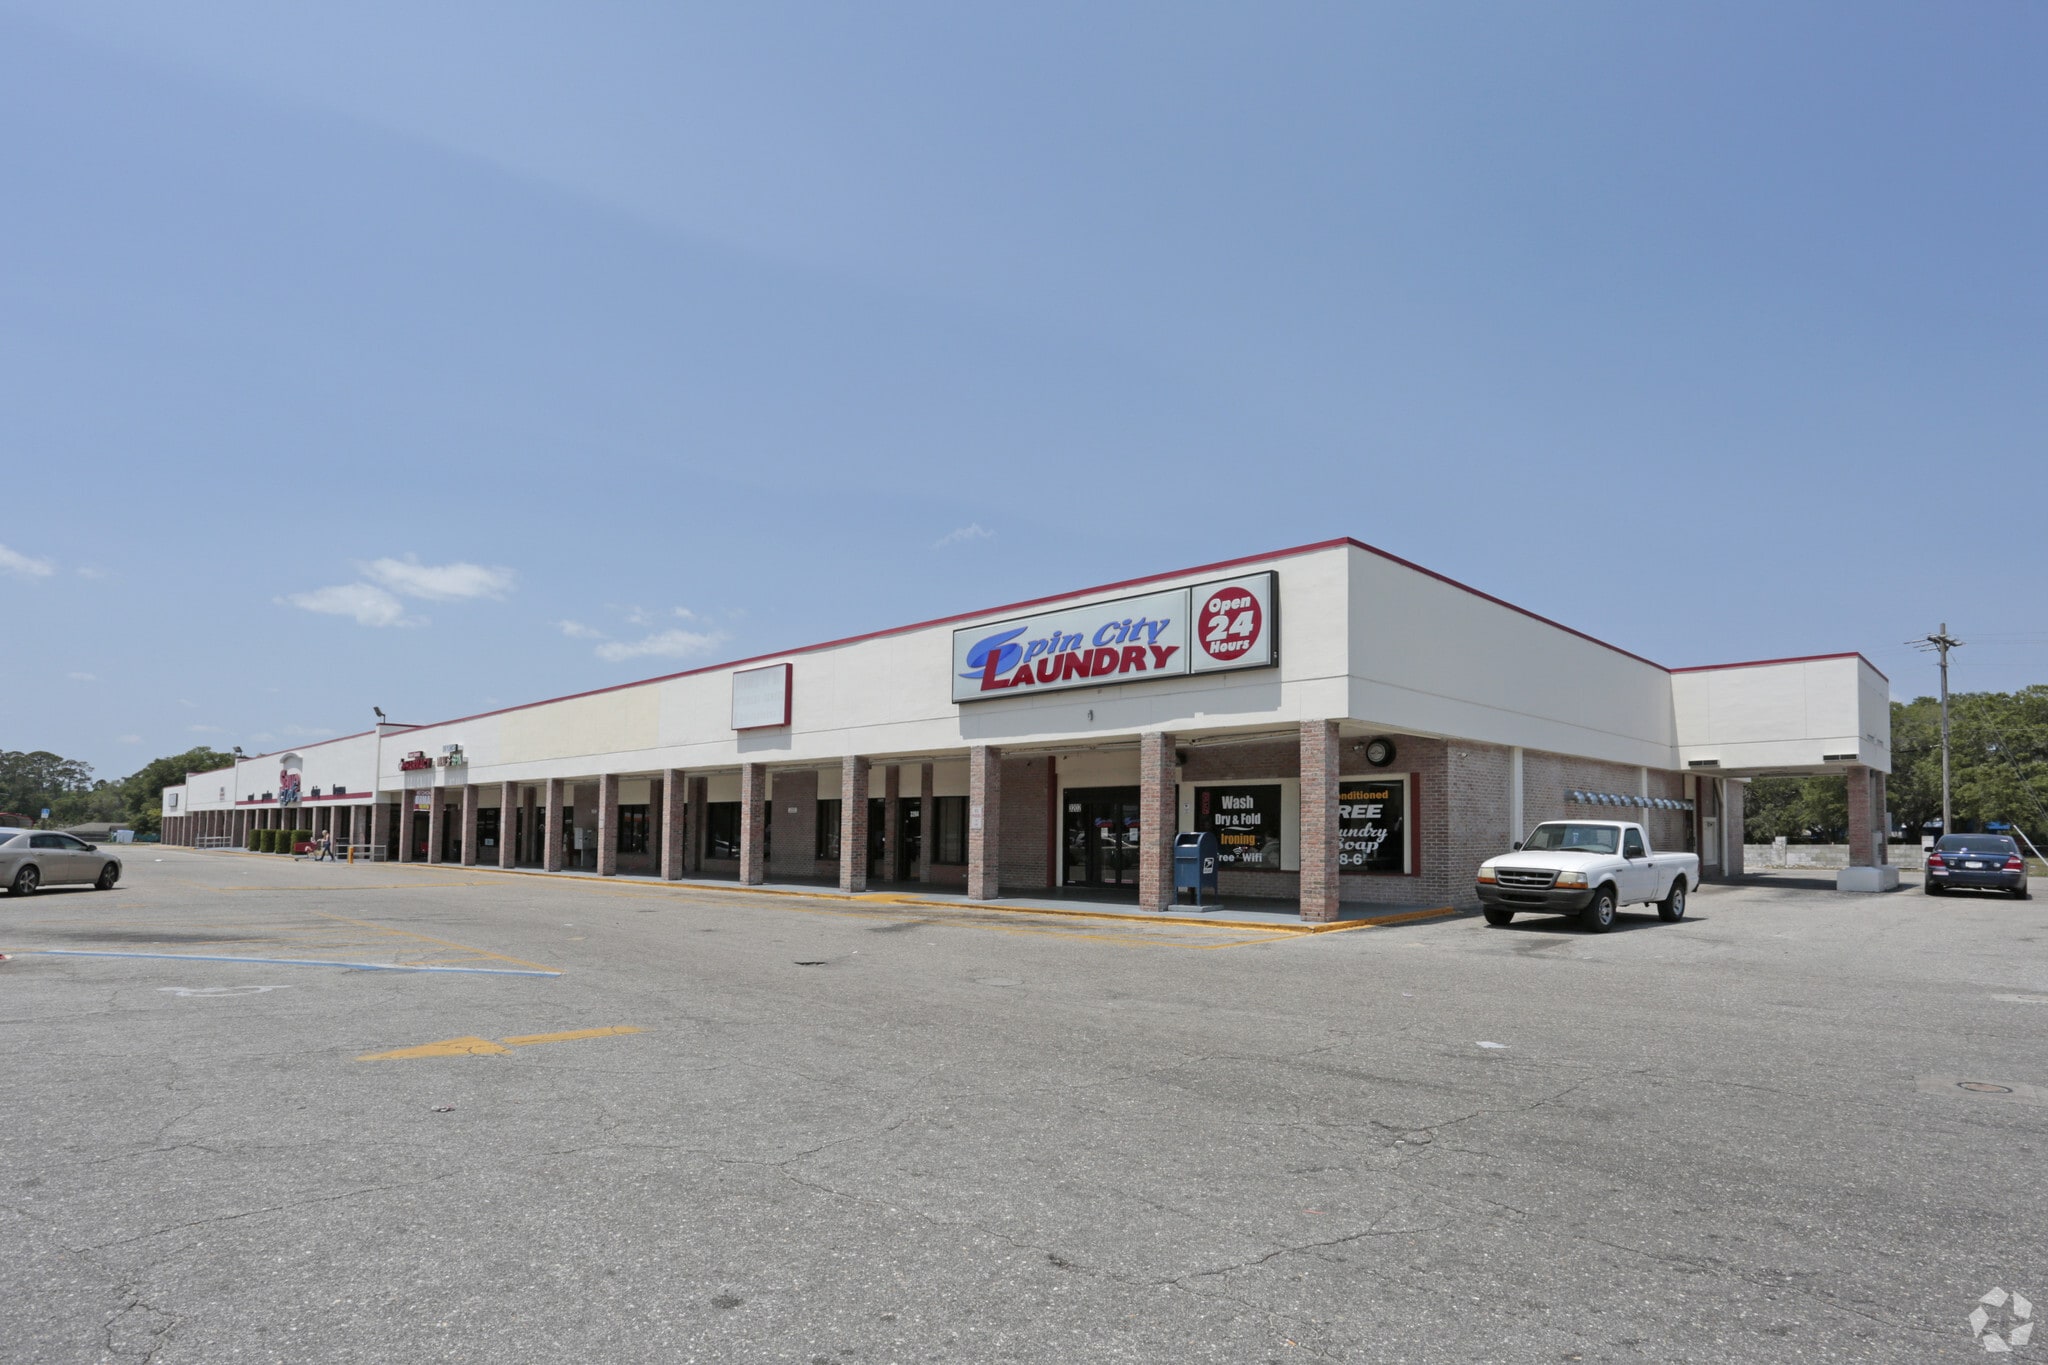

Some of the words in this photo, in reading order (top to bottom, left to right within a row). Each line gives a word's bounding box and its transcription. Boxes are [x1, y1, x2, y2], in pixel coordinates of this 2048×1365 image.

[1208, 595, 1251, 615] Open
[1206, 611, 1254, 641] 24
[958, 626, 1083, 679] Spin
[1093, 617, 1171, 647] City
[1209, 639, 1250, 654] Hours
[980, 645, 1180, 691] LAUNDRY
[1338, 789, 1389, 800] nditioned
[1221, 795, 1254, 810] Wash
[1338, 804, 1384, 819] REE
[1215, 813, 1230, 826] Dry
[1232, 814, 1239, 825] &
[1240, 813, 1261, 825] Fold
[1221, 833, 1256, 846] Ironing
[1338, 822, 1388, 843] undry
[1217, 853, 1235, 862] ree
